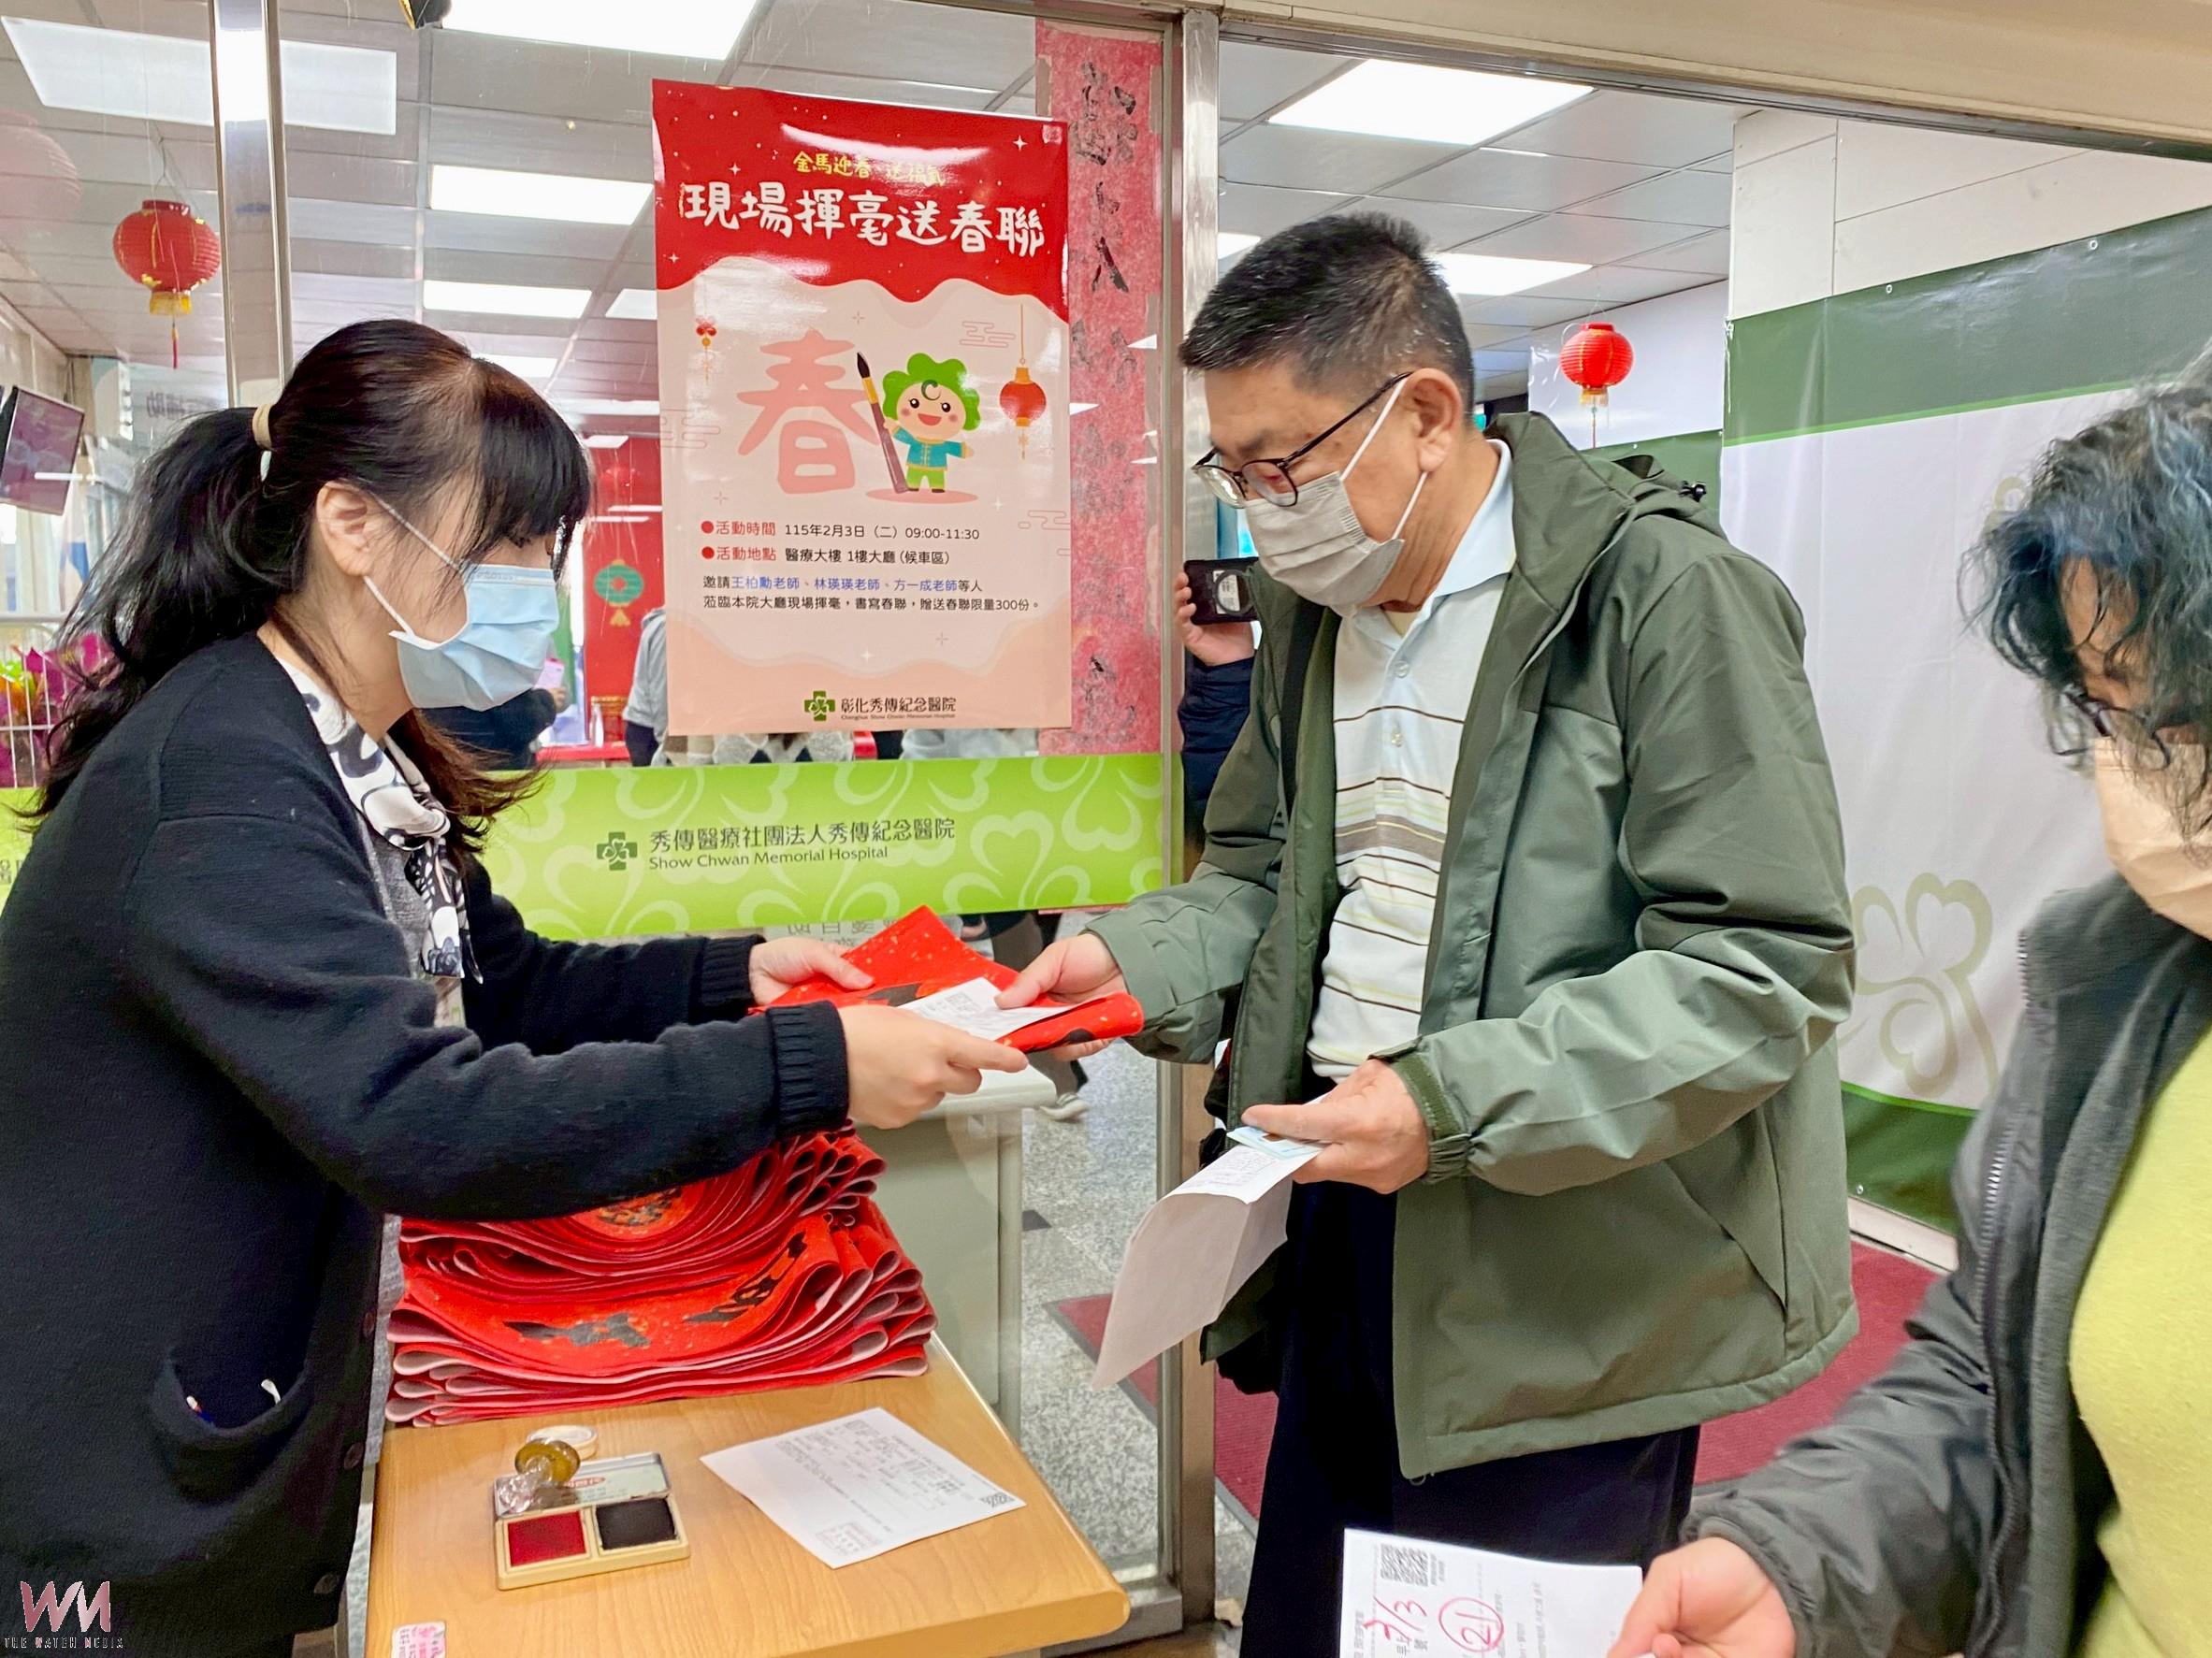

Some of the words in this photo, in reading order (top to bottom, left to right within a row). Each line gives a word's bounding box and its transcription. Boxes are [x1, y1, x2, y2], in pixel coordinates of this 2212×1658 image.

[679, 181, 1046, 257] 現場揮毫送春聯
[737, 327, 882, 496] 春
[716, 520, 776, 536] 活動時間
[716, 546, 777, 561] 活動地點
[785, 547, 842, 562] 醫療大樓
[841, 697, 957, 714] 彰化秀傳紀念醫院
[649, 817, 956, 853] 秀傳醫療社團法人秀傳紀念醫院
[649, 855, 693, 870] Show
[697, 852, 749, 868] Chwan
[754, 848, 825, 865] Memorial
[829, 845, 889, 862] Hospital
